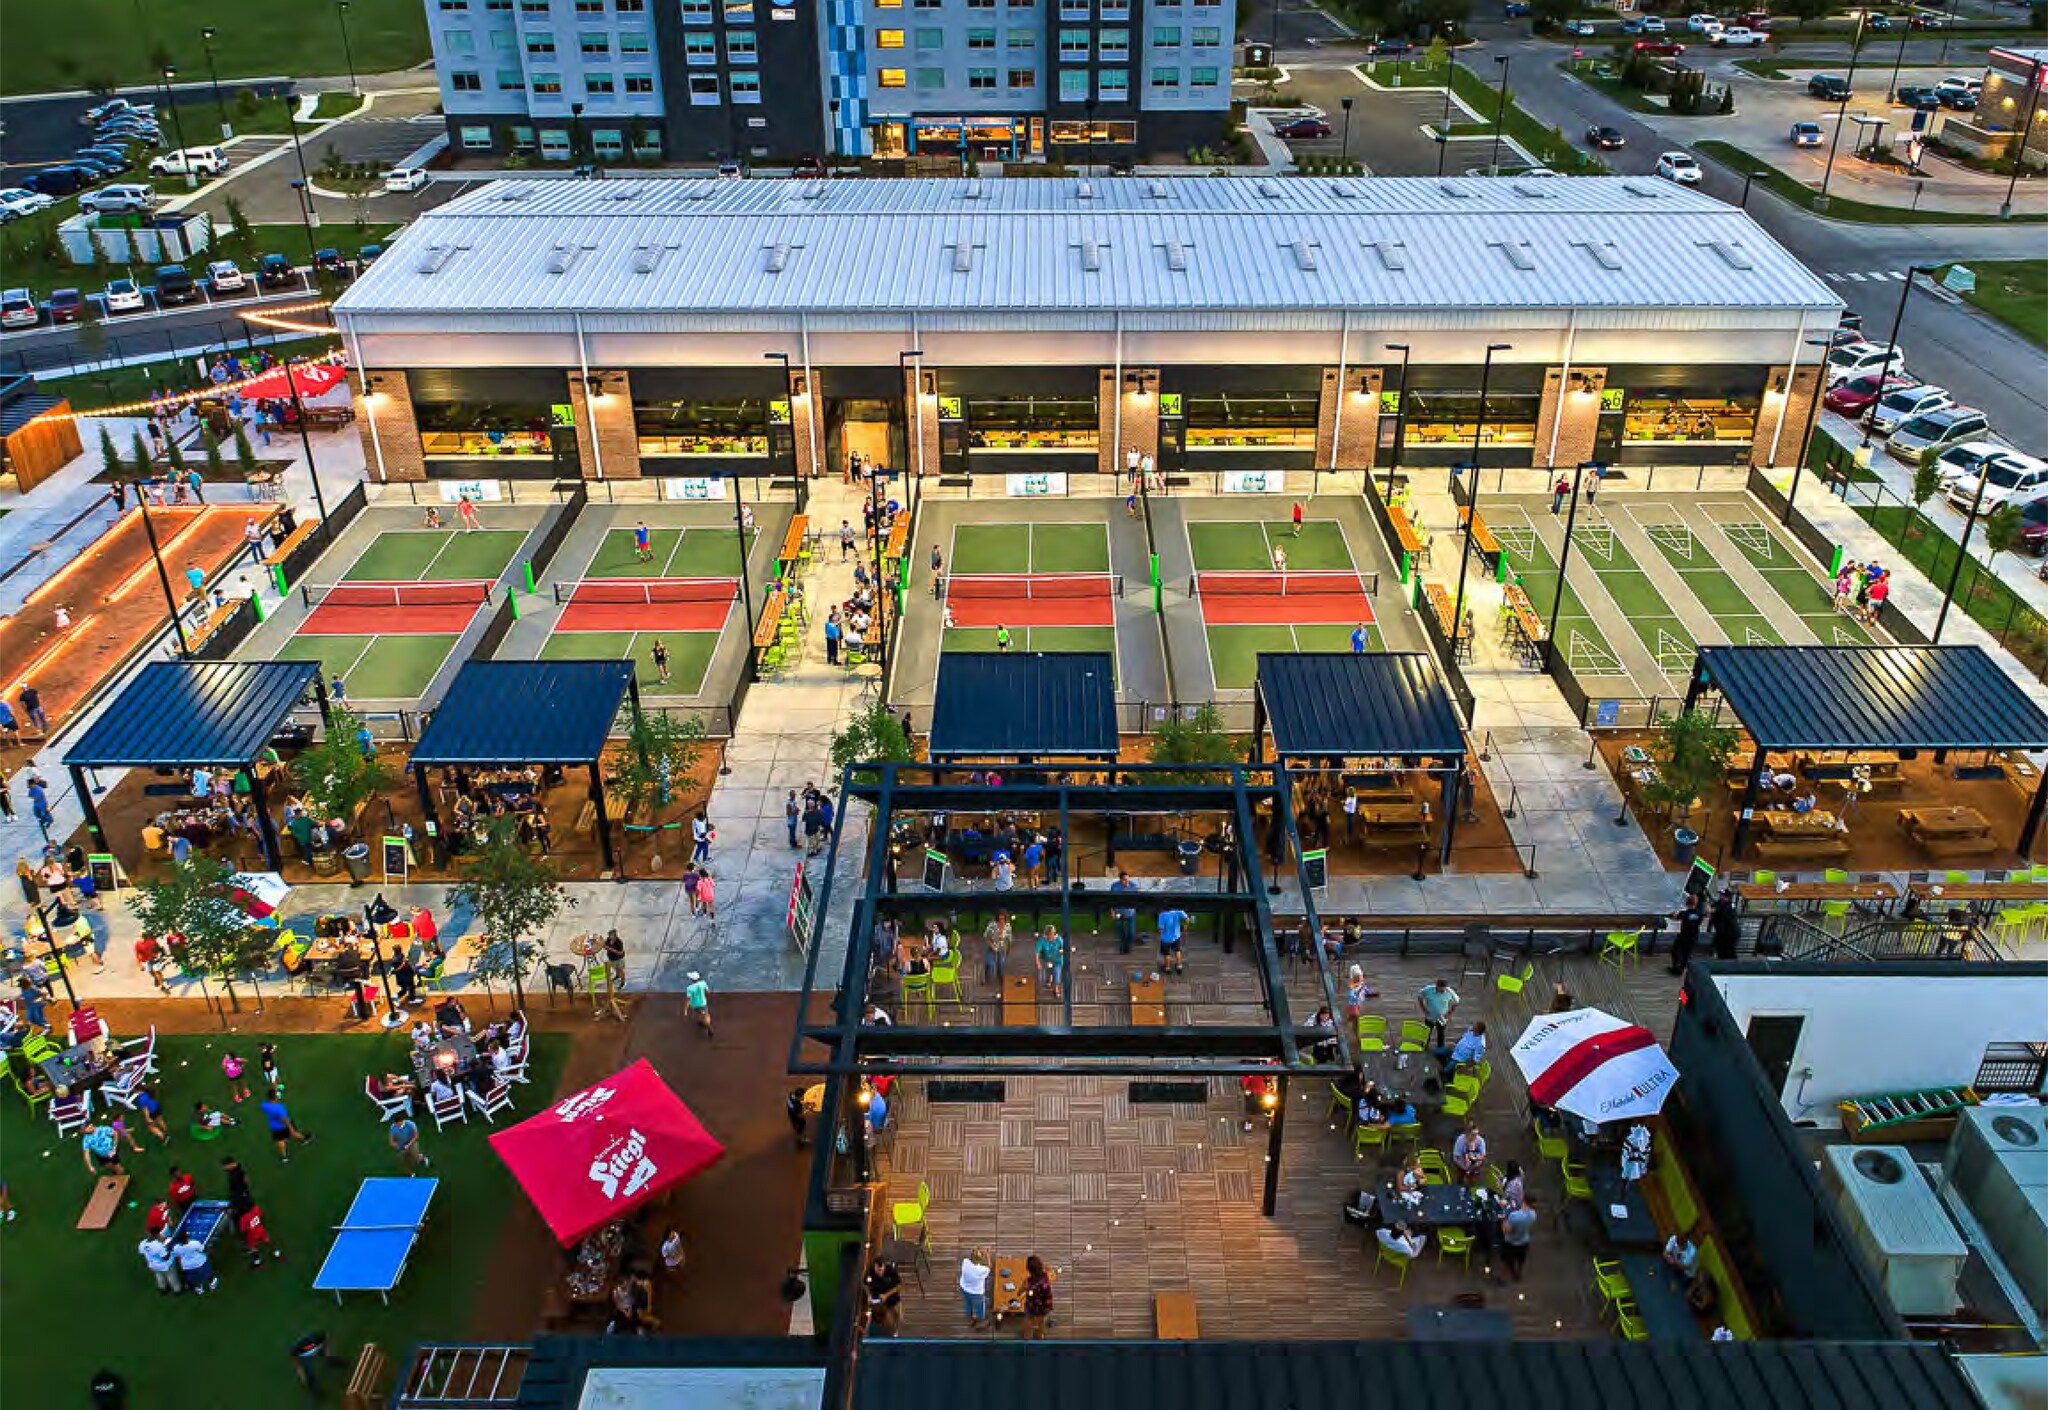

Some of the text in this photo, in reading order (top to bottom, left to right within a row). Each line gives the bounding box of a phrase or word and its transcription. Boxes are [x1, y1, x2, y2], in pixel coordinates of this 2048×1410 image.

[1169, 395, 1180, 411] 4
[1612, 390, 1623, 407] 6
[563, 406, 572, 422] 1
[950, 399, 960, 415] 3
[1637, 1069, 1671, 1097] ULTRA
[588, 1128, 647, 1200] Stiegl
